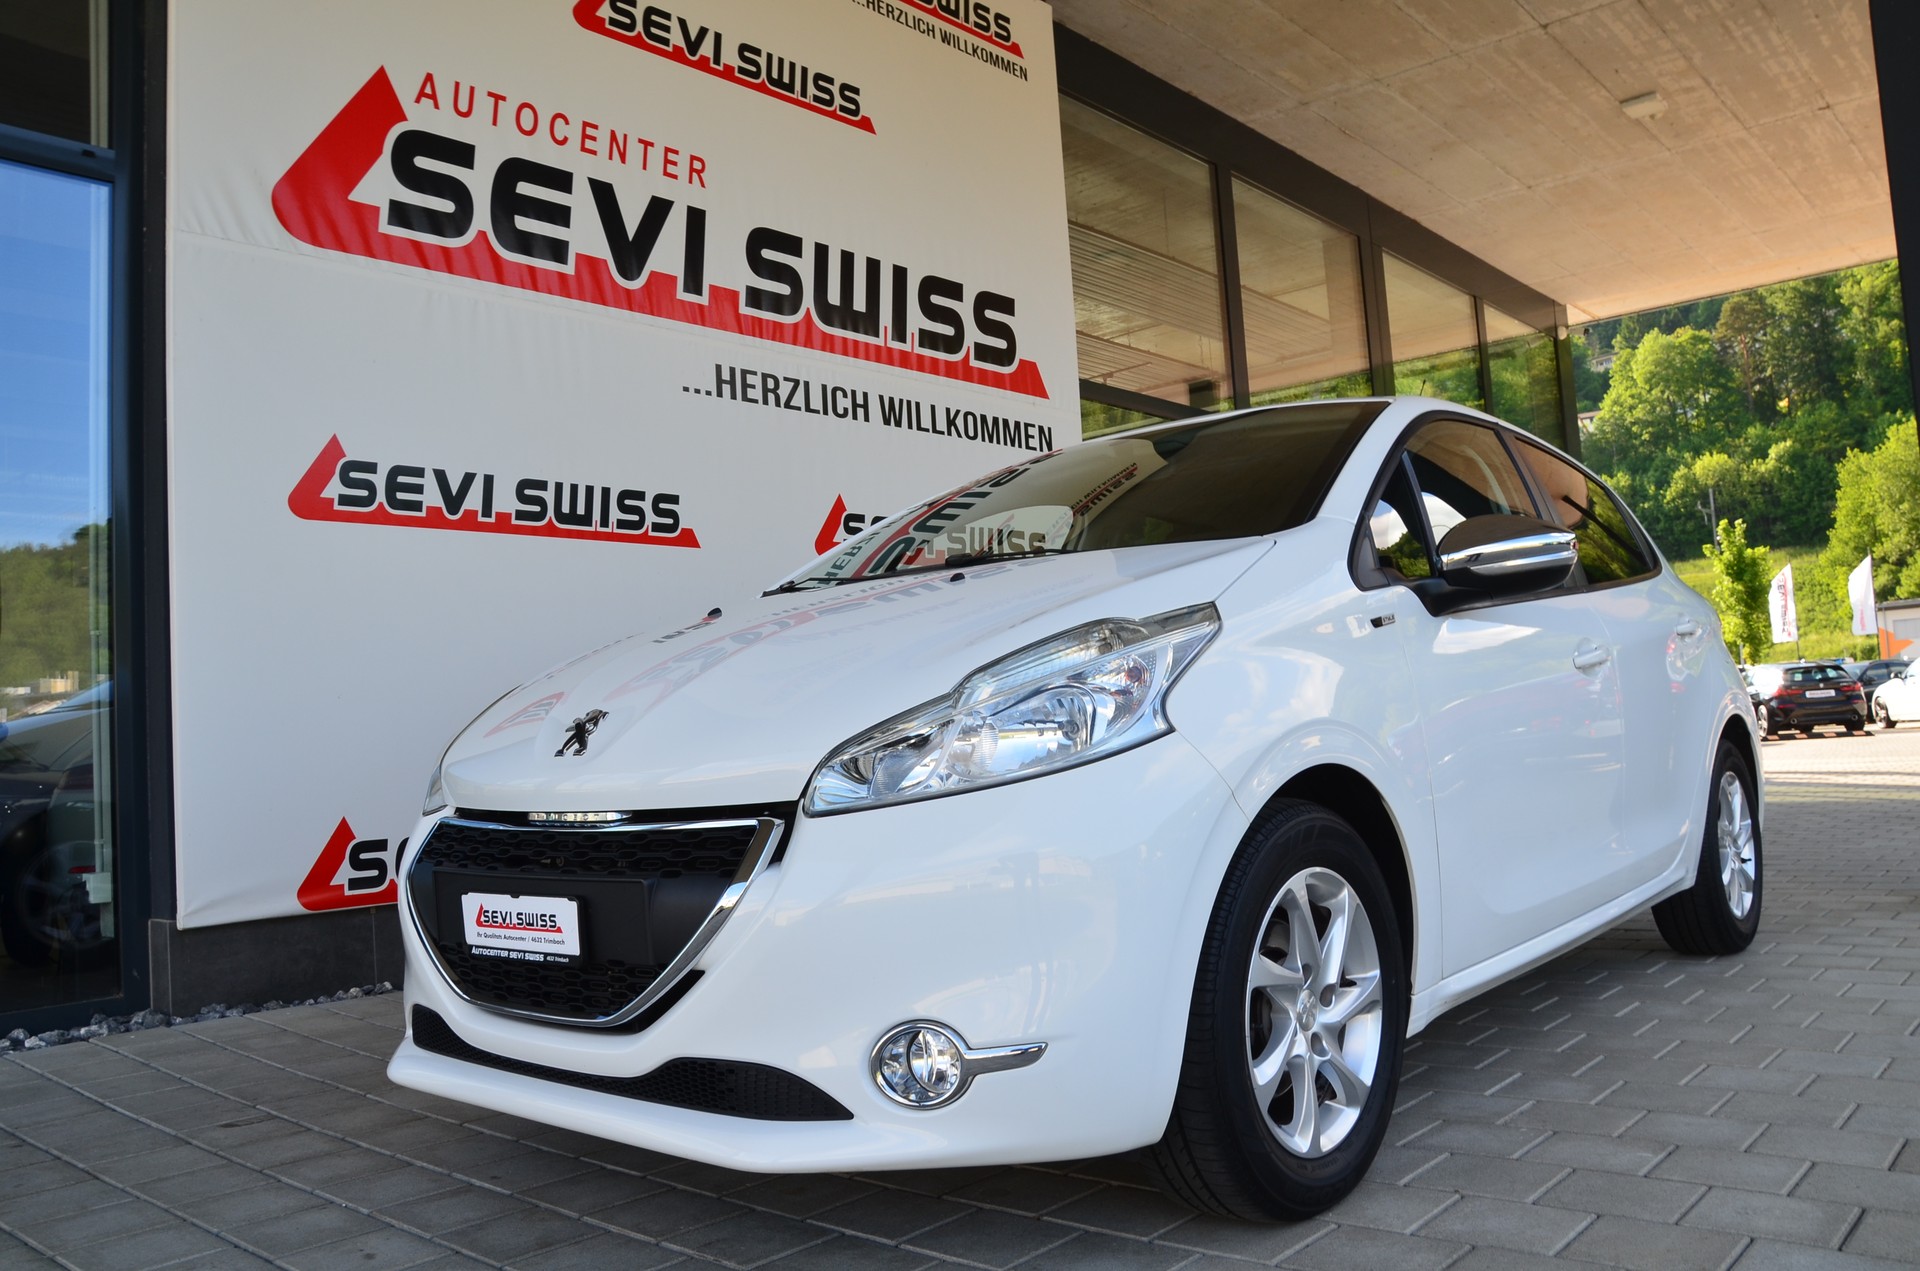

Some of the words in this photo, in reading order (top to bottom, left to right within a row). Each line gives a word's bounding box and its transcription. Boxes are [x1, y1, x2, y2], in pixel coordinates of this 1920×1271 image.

[913, 0, 1012, 44] WISS
[608, 0, 723, 67] SEVI
[737, 42, 861, 118] SWISS
[939, 27, 1028, 82] WILLKOMMEN
[414, 72, 706, 188] AUTOCENTER
[387, 129, 707, 297] SEVI
[744, 226, 1017, 368] SWISS
[878, 394, 1053, 453] WILLKOMMEN
[337, 459, 495, 519] SEVI
[514, 478, 680, 534] SWISS
[482, 909, 513, 925] SEVI
[516, 912, 557, 929] SWISS
[503, 934, 527, 942] Autocenter
[543, 937, 565, 945] Trimbach
[509, 951, 524, 960] SEVI
[525, 952, 544, 962] SWISS
